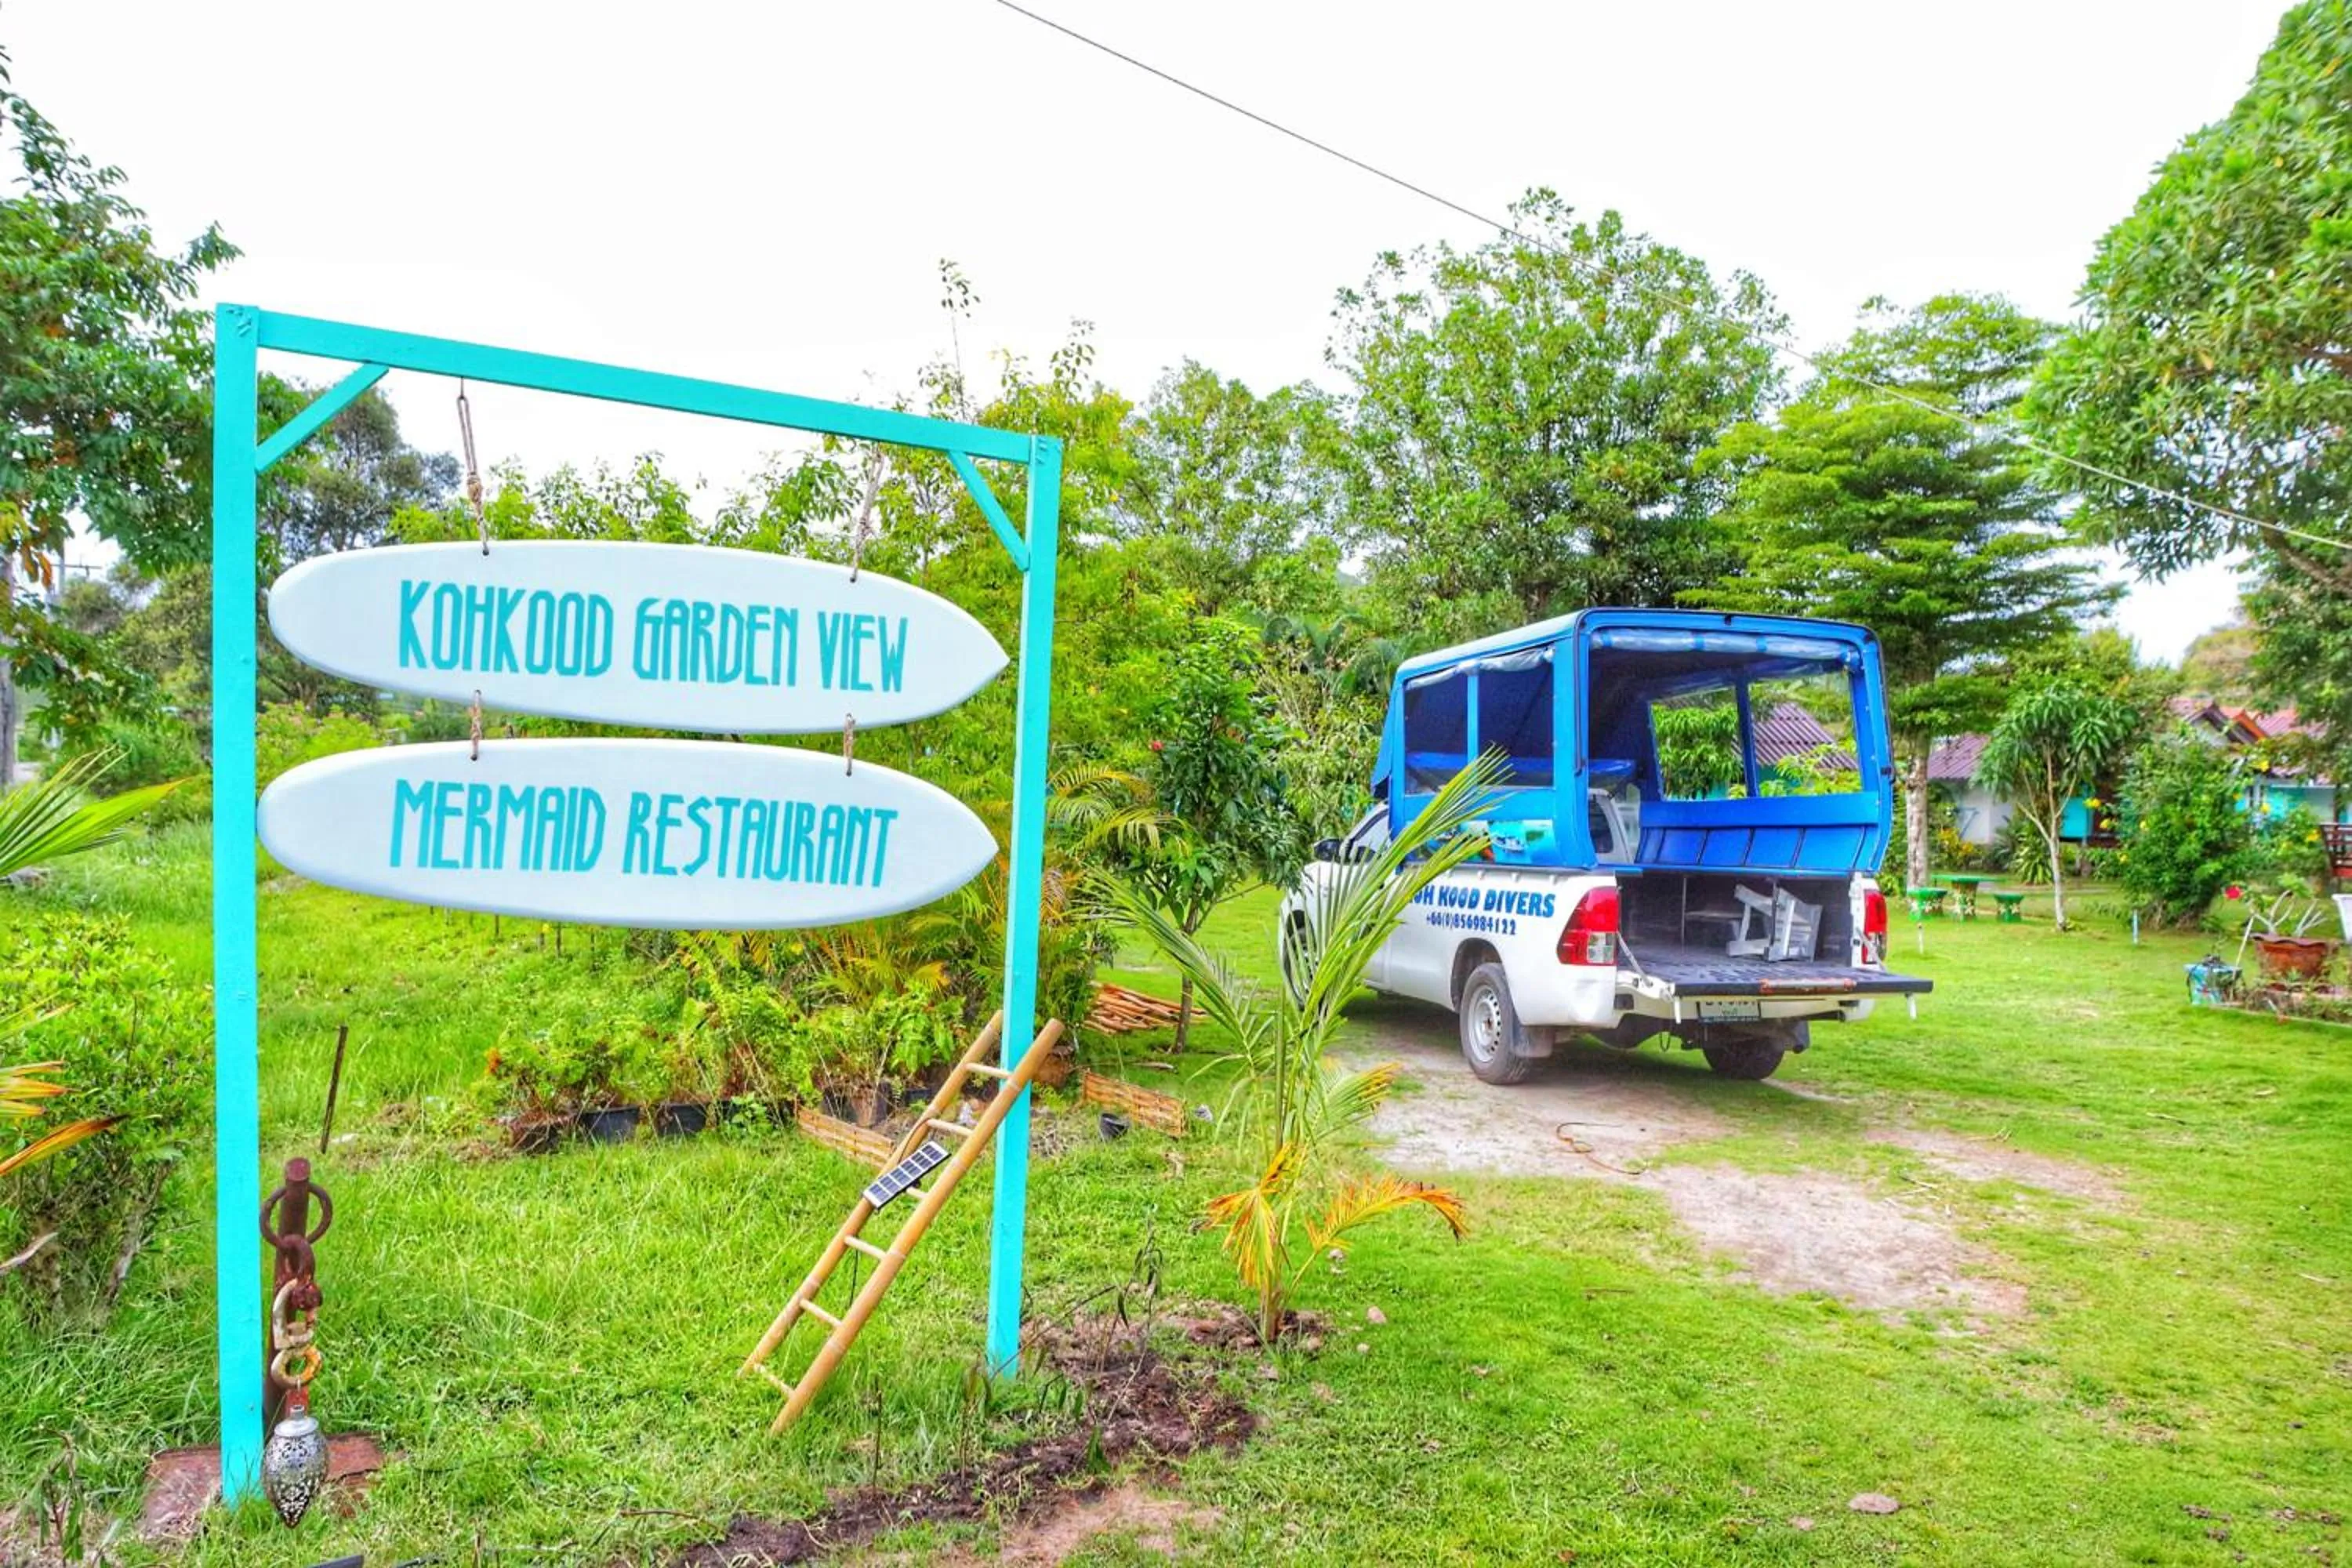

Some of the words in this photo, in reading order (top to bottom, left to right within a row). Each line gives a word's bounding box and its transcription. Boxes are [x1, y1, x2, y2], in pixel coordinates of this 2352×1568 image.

[399, 580, 614, 677] KOHKOOD
[632, 597, 800, 688] GARDEN
[817, 610, 909, 693] VIEW
[389, 779, 607, 872] MERMAID
[622, 790, 900, 888] RESTAURANT
[1410, 884, 1435, 905] OH
[1439, 885, 1481, 909] KOOD
[1483, 888, 1556, 918] DIVERS
